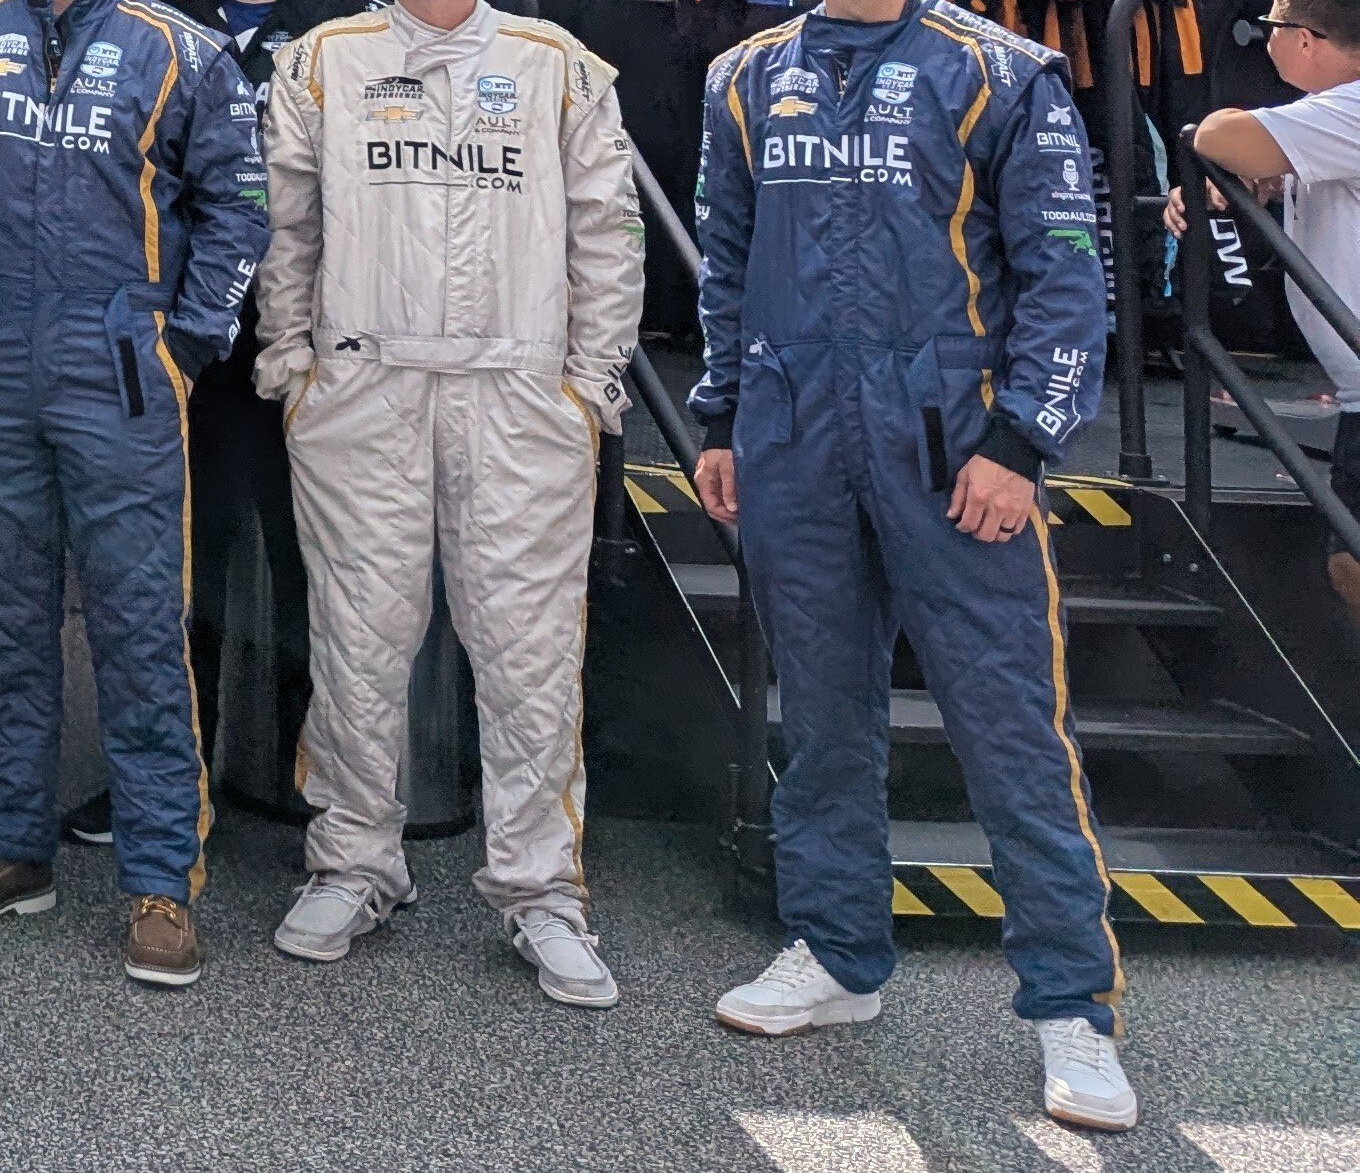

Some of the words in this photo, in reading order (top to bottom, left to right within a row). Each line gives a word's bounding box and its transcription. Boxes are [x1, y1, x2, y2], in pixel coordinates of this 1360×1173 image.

[72, 77, 118, 91] AULT
[377, 84, 425, 94] INDYCAR
[364, 92, 424, 100] EXPERIENCE
[867, 103, 914, 118] AULT
[475, 116, 522, 128] AULT
[763, 133, 913, 170] BITNILE
[367, 140, 524, 178] BITNILE
